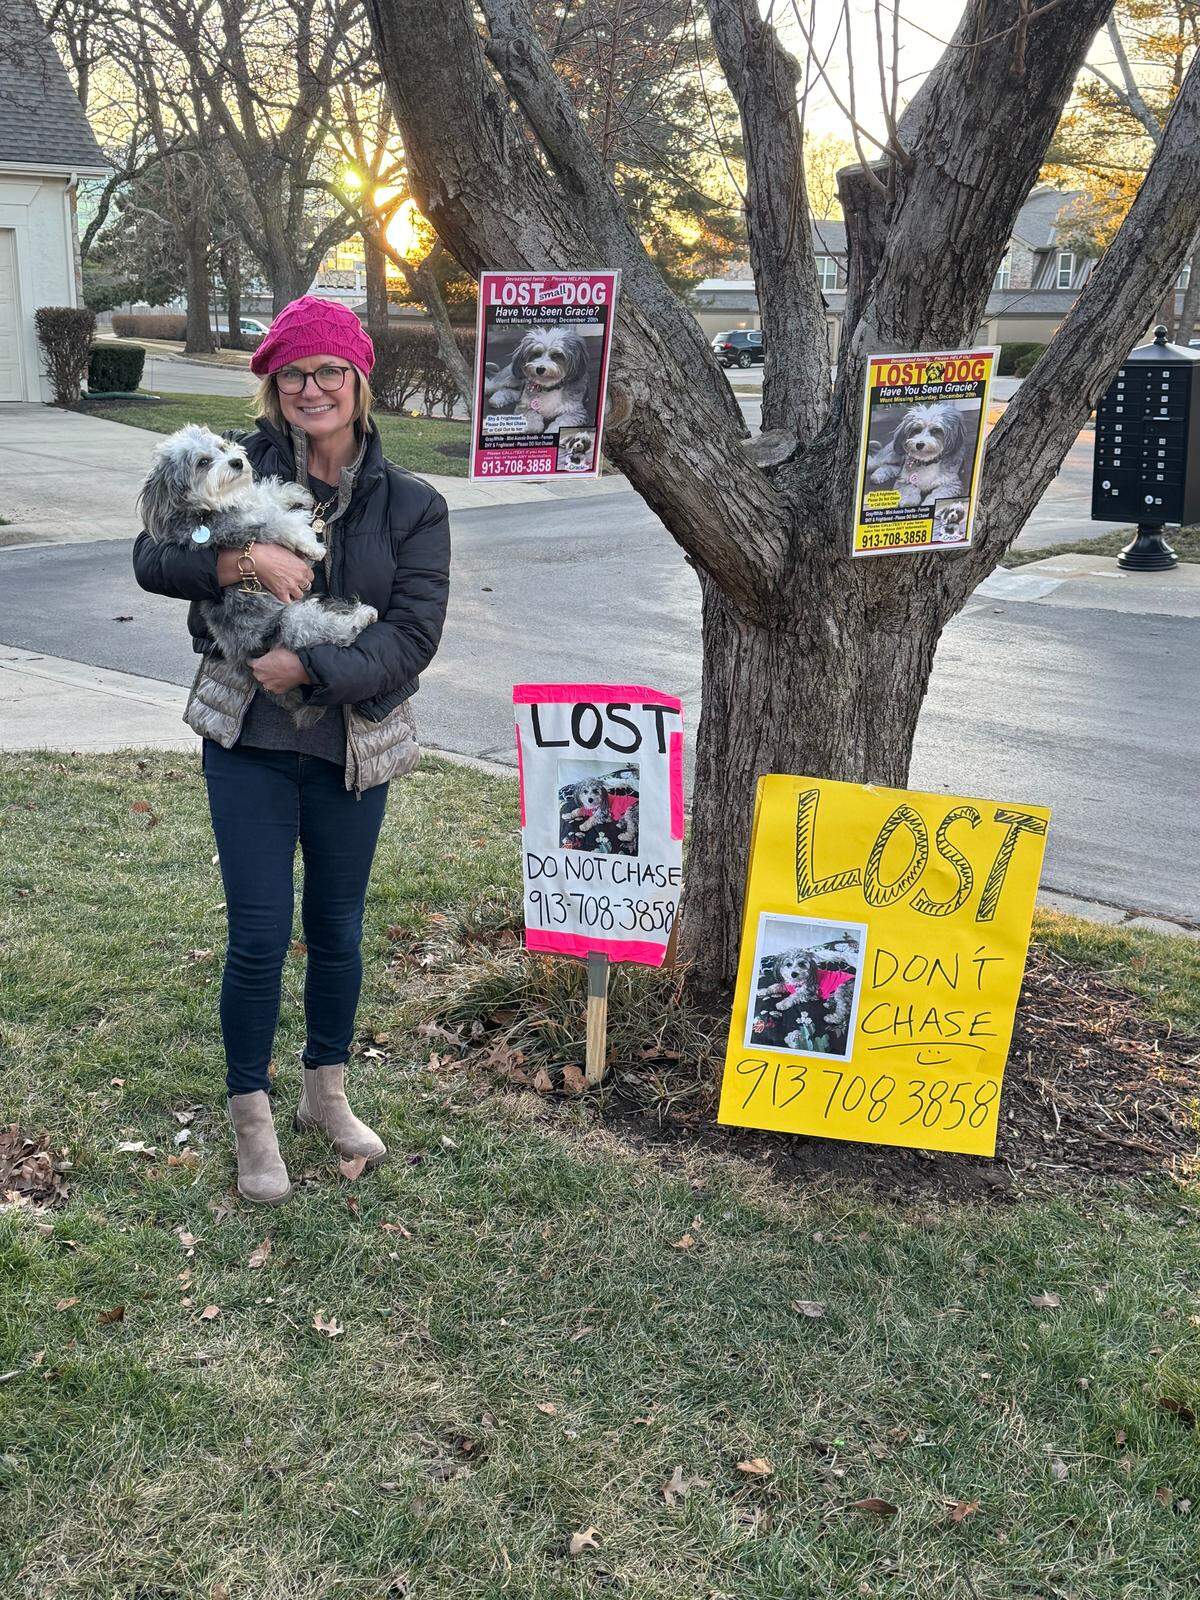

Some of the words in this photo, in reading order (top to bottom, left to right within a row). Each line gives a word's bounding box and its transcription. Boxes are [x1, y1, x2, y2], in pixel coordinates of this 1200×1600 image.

[490, 283, 545, 305] LOST
[538, 284, 567, 301] small
[562, 282, 606, 305] DOG
[495, 306, 519, 317] Have
[521, 306, 538, 317] You
[540, 306, 562, 317] Seen
[565, 306, 600, 317] Gracie?
[511, 317, 531, 325] Missing
[875, 363, 927, 387] LOST
[944, 360, 985, 382] DOG
[880, 387, 902, 397] Have
[904, 385, 919, 396] You
[921, 384, 943, 395] Seen
[945, 382, 979, 393] Gracie?
[893, 396, 914, 404] Missing
[481, 459, 552, 475] 913-708-3858
[862, 530, 927, 548] 913-708-3858
[531, 702, 681, 754] LOST
[796, 788, 1048, 923] LOST
[527, 853, 558, 880] DO
[565, 855, 607, 882] NOT
[611, 860, 682, 888] CHASE
[528, 889, 676, 934] 913-708-3858
[871, 945, 1004, 991] DON'T
[860, 1002, 998, 1038] CHASE
[736, 1058, 806, 1109] 913
[822, 1069, 896, 1124] 708
[898, 1079, 999, 1130] 3858
